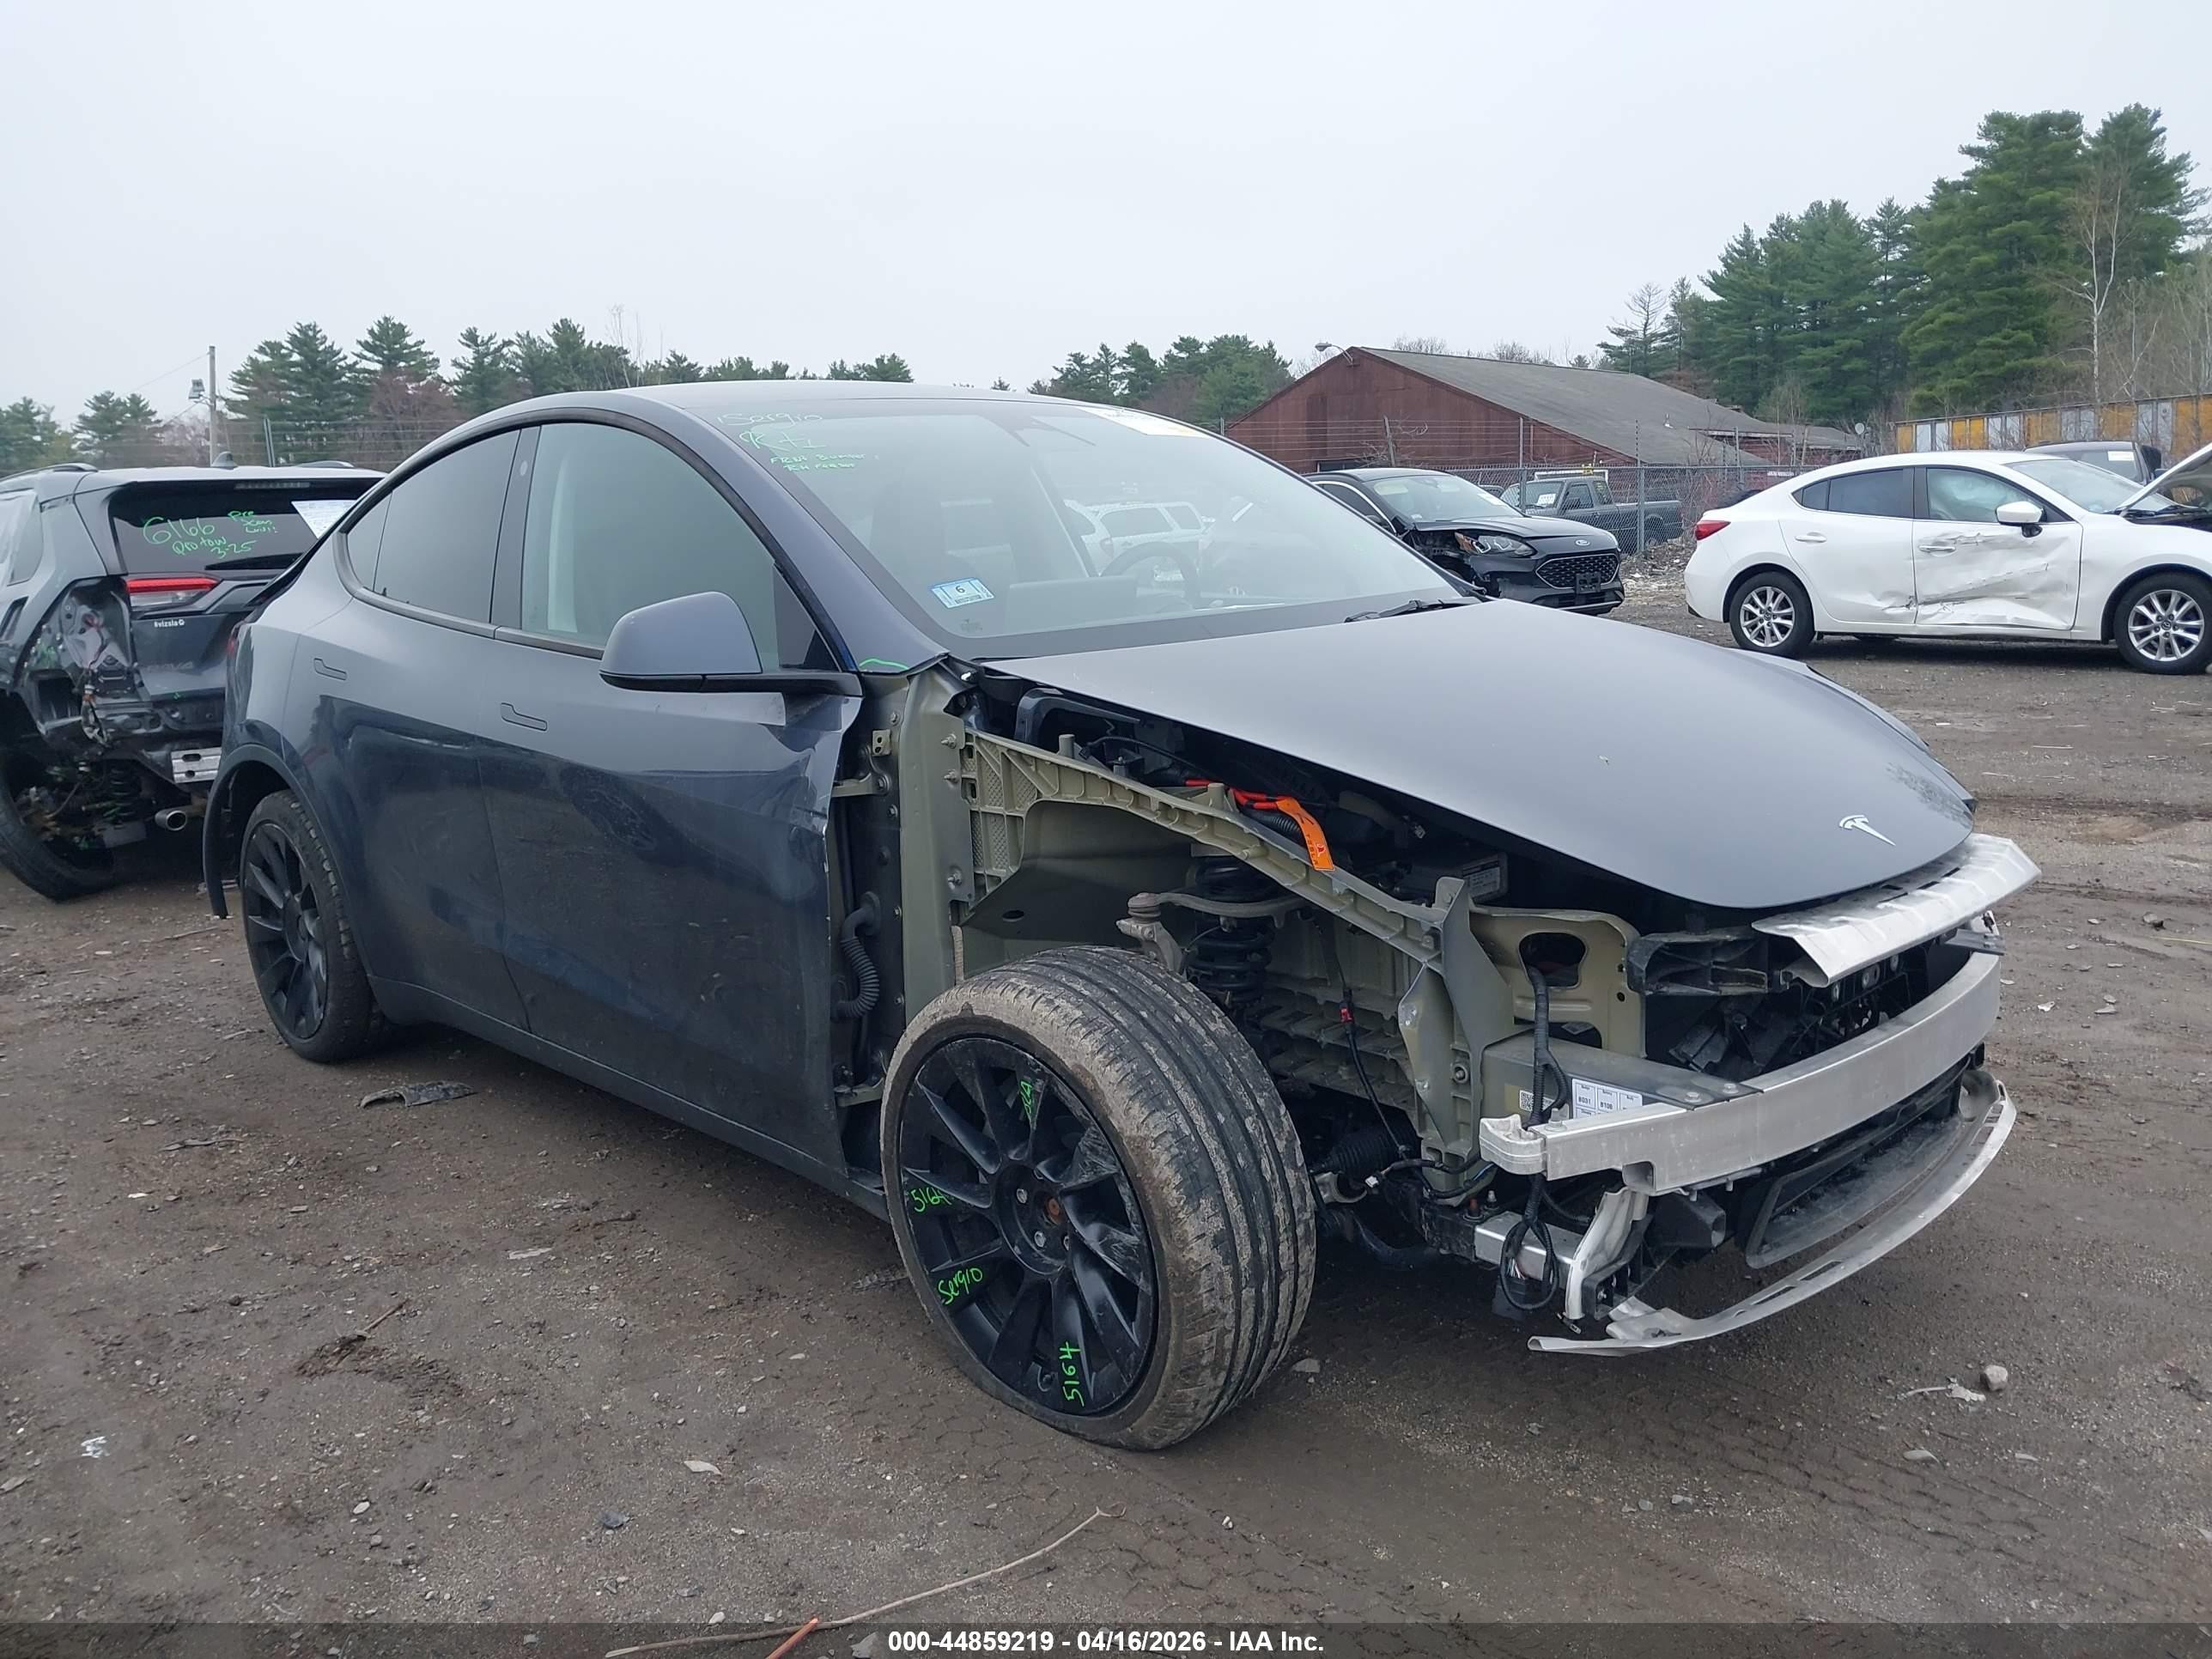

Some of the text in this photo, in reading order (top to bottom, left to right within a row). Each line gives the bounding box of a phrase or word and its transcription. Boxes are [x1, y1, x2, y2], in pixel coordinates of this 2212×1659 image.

[143, 516, 215, 544] 6166
[955, 585, 966, 594] 6
[1059, 1341, 1085, 1407] 5164
